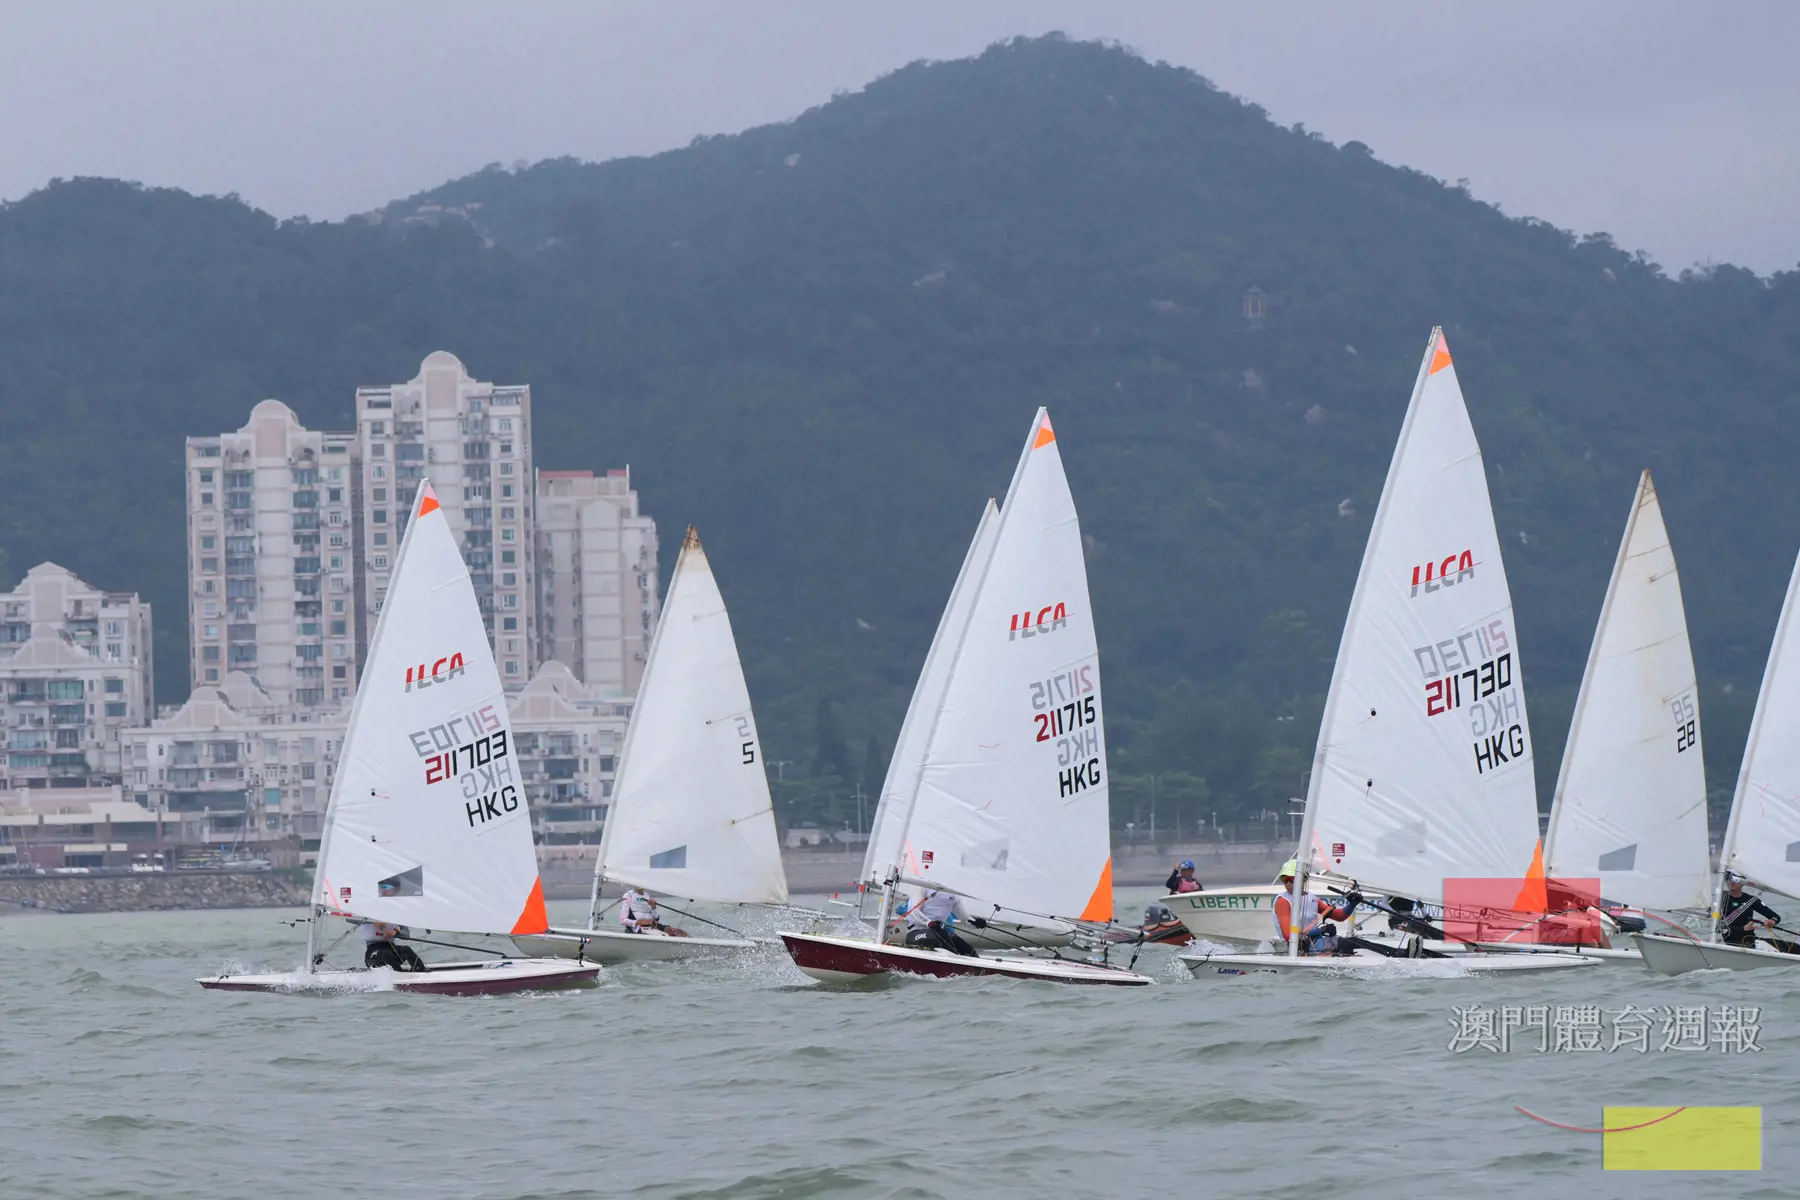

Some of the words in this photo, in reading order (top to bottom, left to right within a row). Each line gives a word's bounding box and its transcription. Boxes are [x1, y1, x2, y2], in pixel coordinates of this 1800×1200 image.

[1410, 549, 1475, 598] ILCA
[1008, 602, 1067, 642] ILCA
[405, 652, 466, 693] ILCA
[1425, 652, 1511, 717] 211730
[1033, 695, 1096, 742] 211715
[1676, 719, 1696, 753] 28
[425, 729, 508, 785] 211703
[742, 741, 755, 765] 5
[1473, 724, 1524, 774] HKG
[1058, 757, 1101, 798] HKG
[466, 785, 519, 828] HKG
[1190, 896, 1260, 909] LIBERTY
[1217, 967, 1240, 975] Laser
